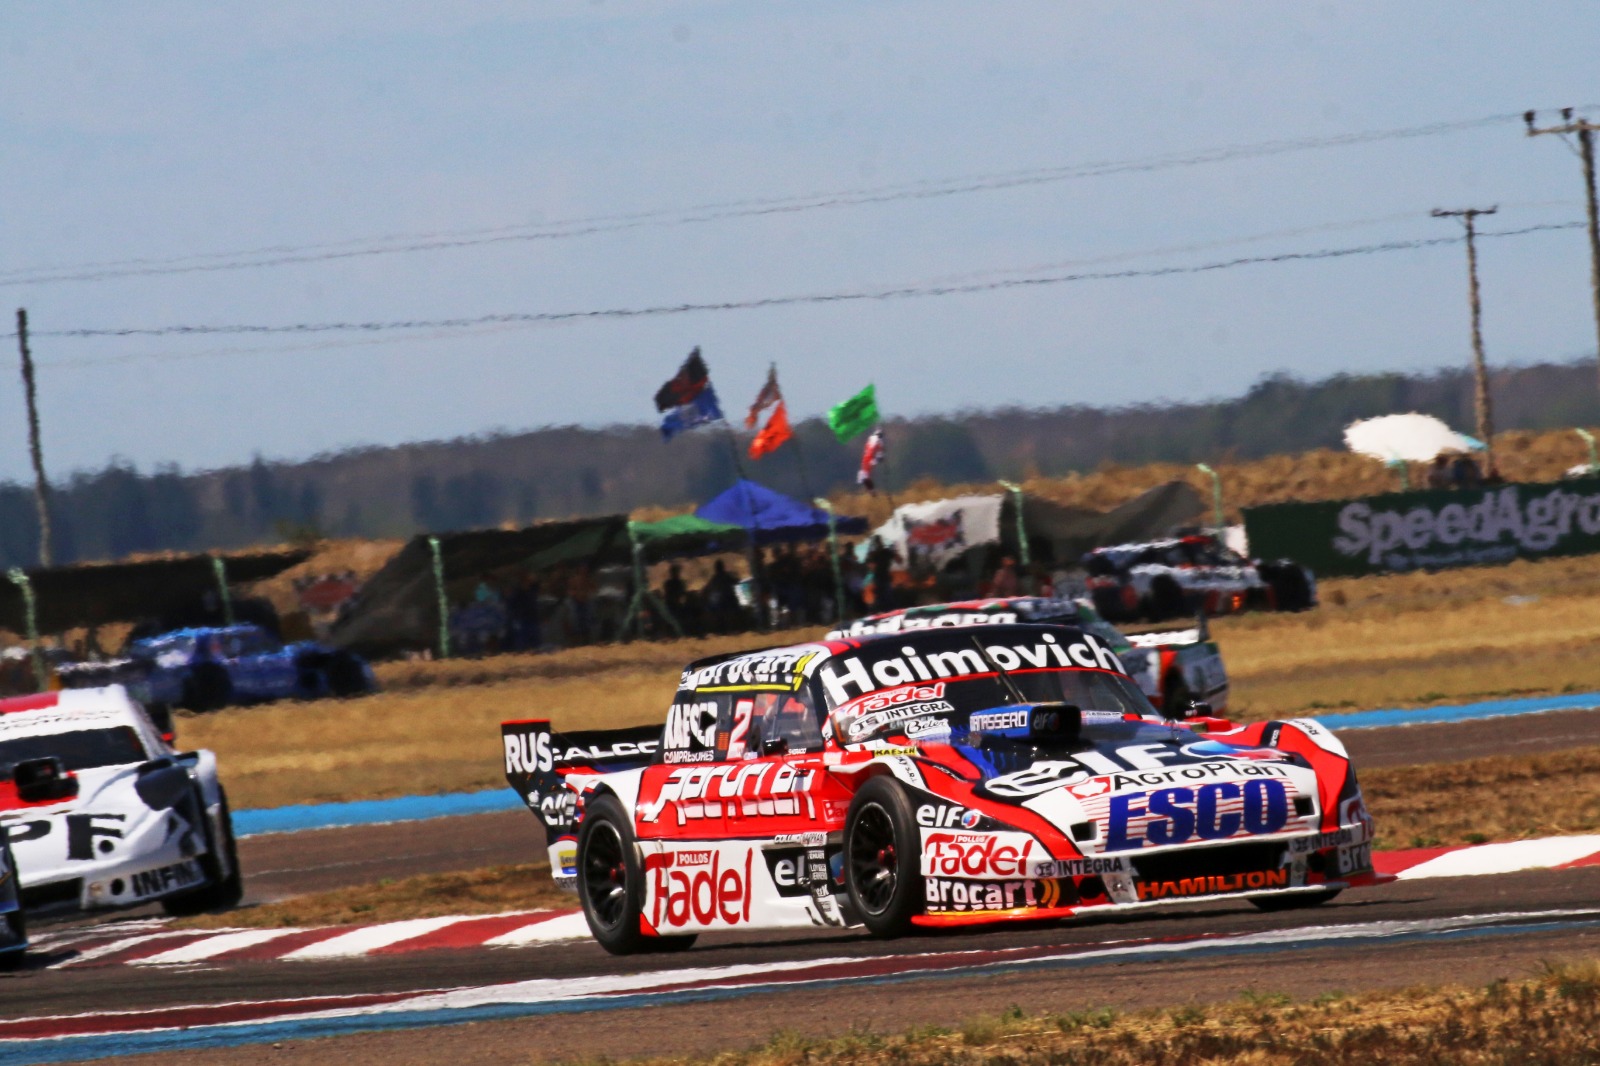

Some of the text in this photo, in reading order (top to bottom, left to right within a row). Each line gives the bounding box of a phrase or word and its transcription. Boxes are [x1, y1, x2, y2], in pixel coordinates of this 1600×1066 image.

[1334, 486, 1600, 564] SpeedAgro
[820, 634, 1127, 705] Haimovich
[886, 702, 951, 720] INTEGRA
[503, 731, 553, 774] RUS
[1113, 761, 1287, 791] AgroPlan
[1105, 778, 1289, 853] ESCO
[679, 853, 710, 865] POLLOS
[925, 833, 1034, 877] Fadel
[1058, 858, 1124, 876] INTEGRA
[644, 847, 753, 929] Fadel
[925, 876, 1037, 911] Brocart
[1136, 868, 1287, 899] HAMILTON
